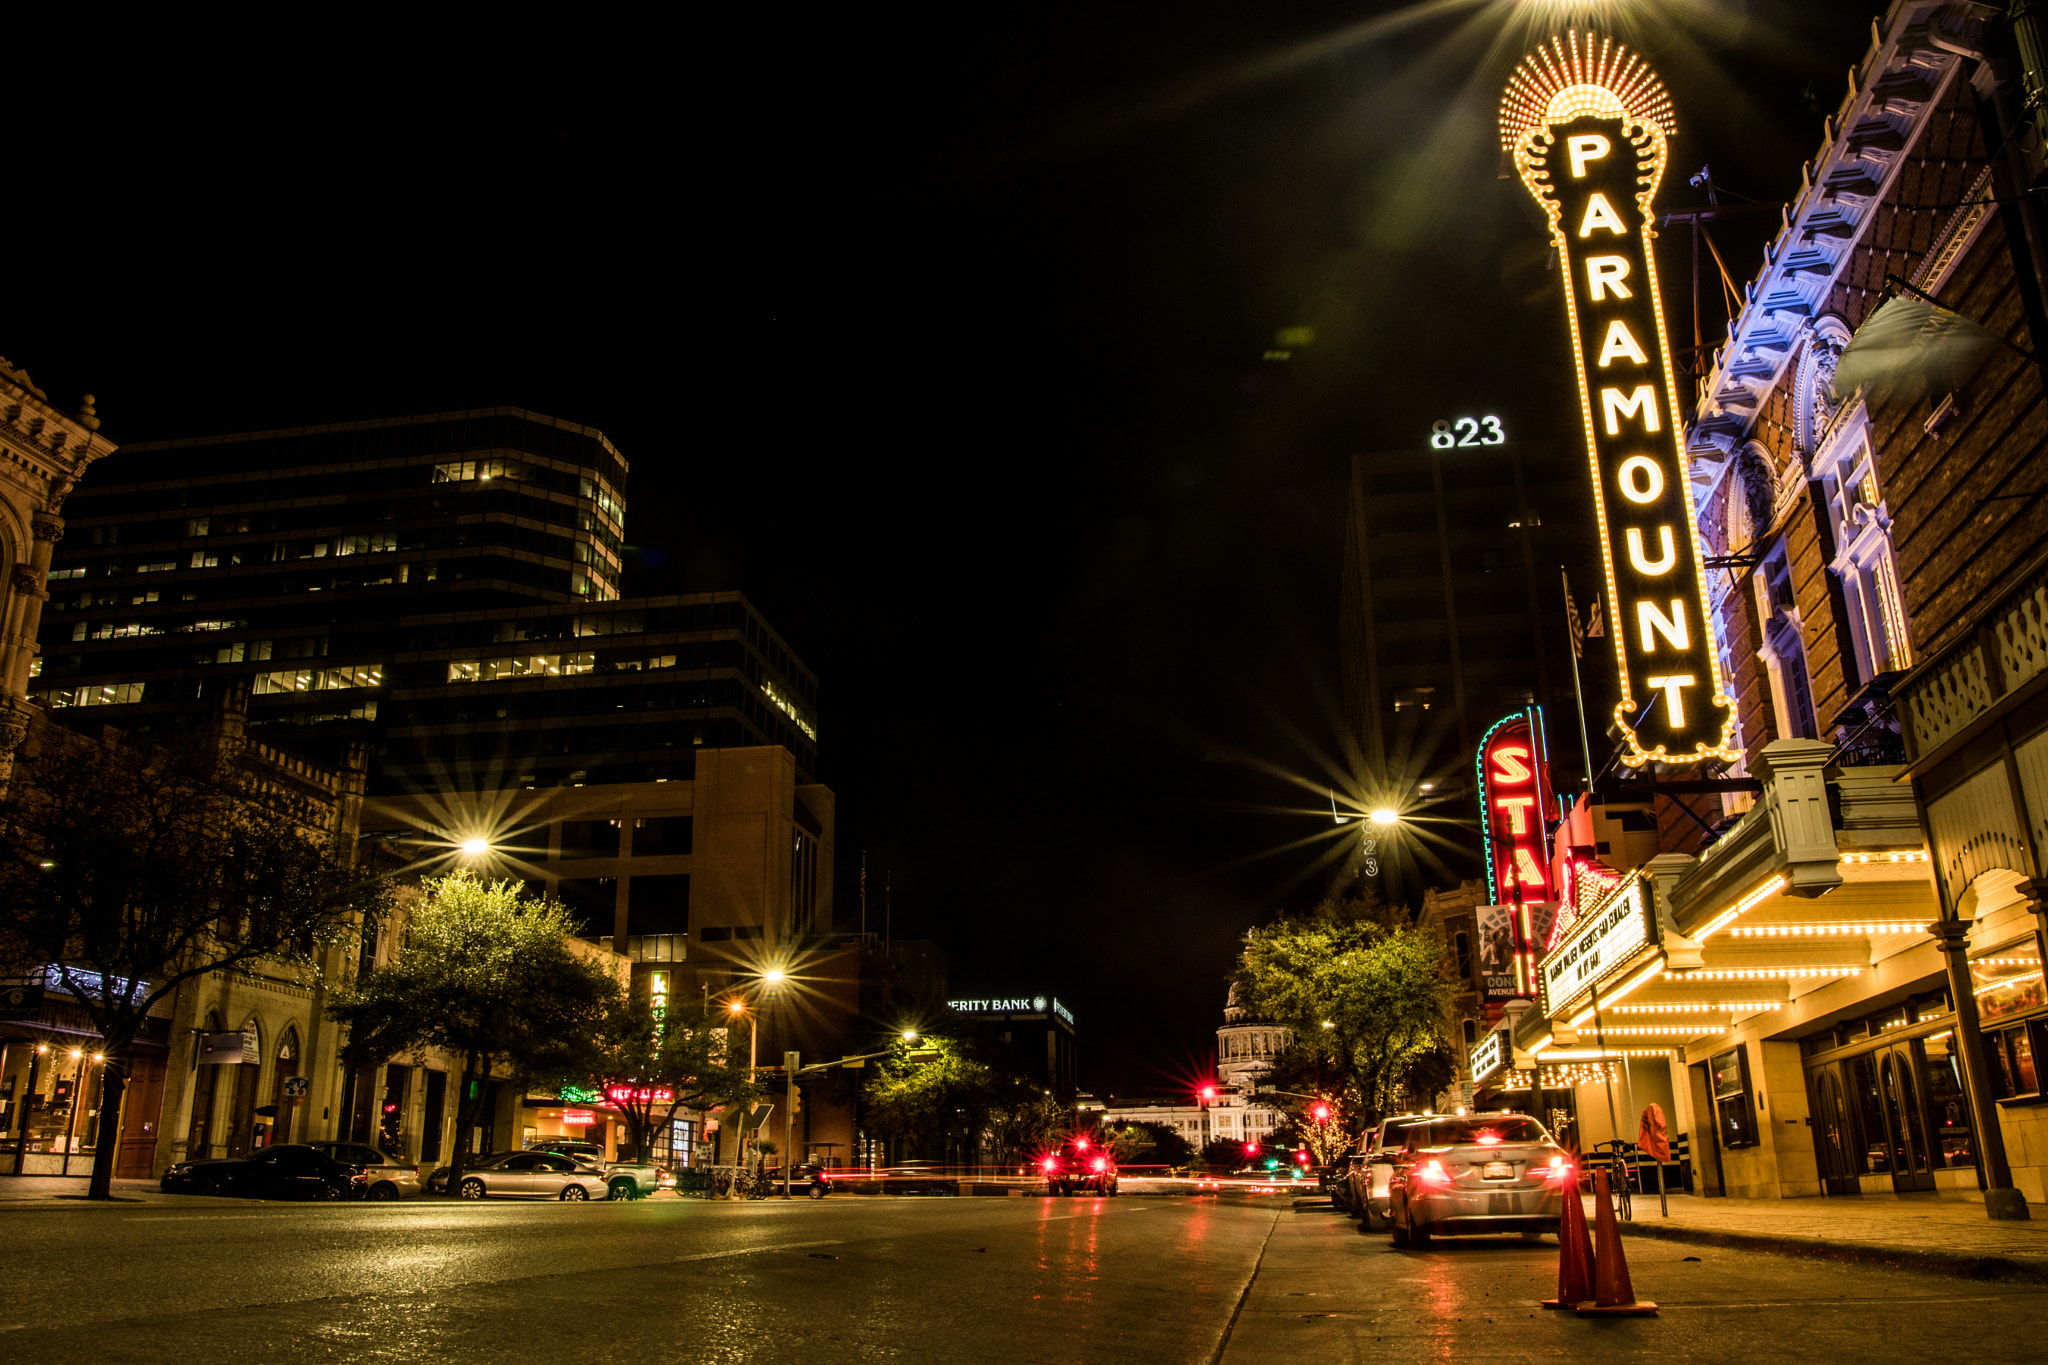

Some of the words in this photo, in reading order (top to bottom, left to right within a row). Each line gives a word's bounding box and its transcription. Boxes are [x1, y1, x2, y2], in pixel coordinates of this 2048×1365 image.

[1431, 415, 1505, 449] 823
[1566, 134, 1696, 729] PARAMOUNT
[1488, 987, 1516, 996] AVENUE
[992, 999, 1031, 1011] BANK
